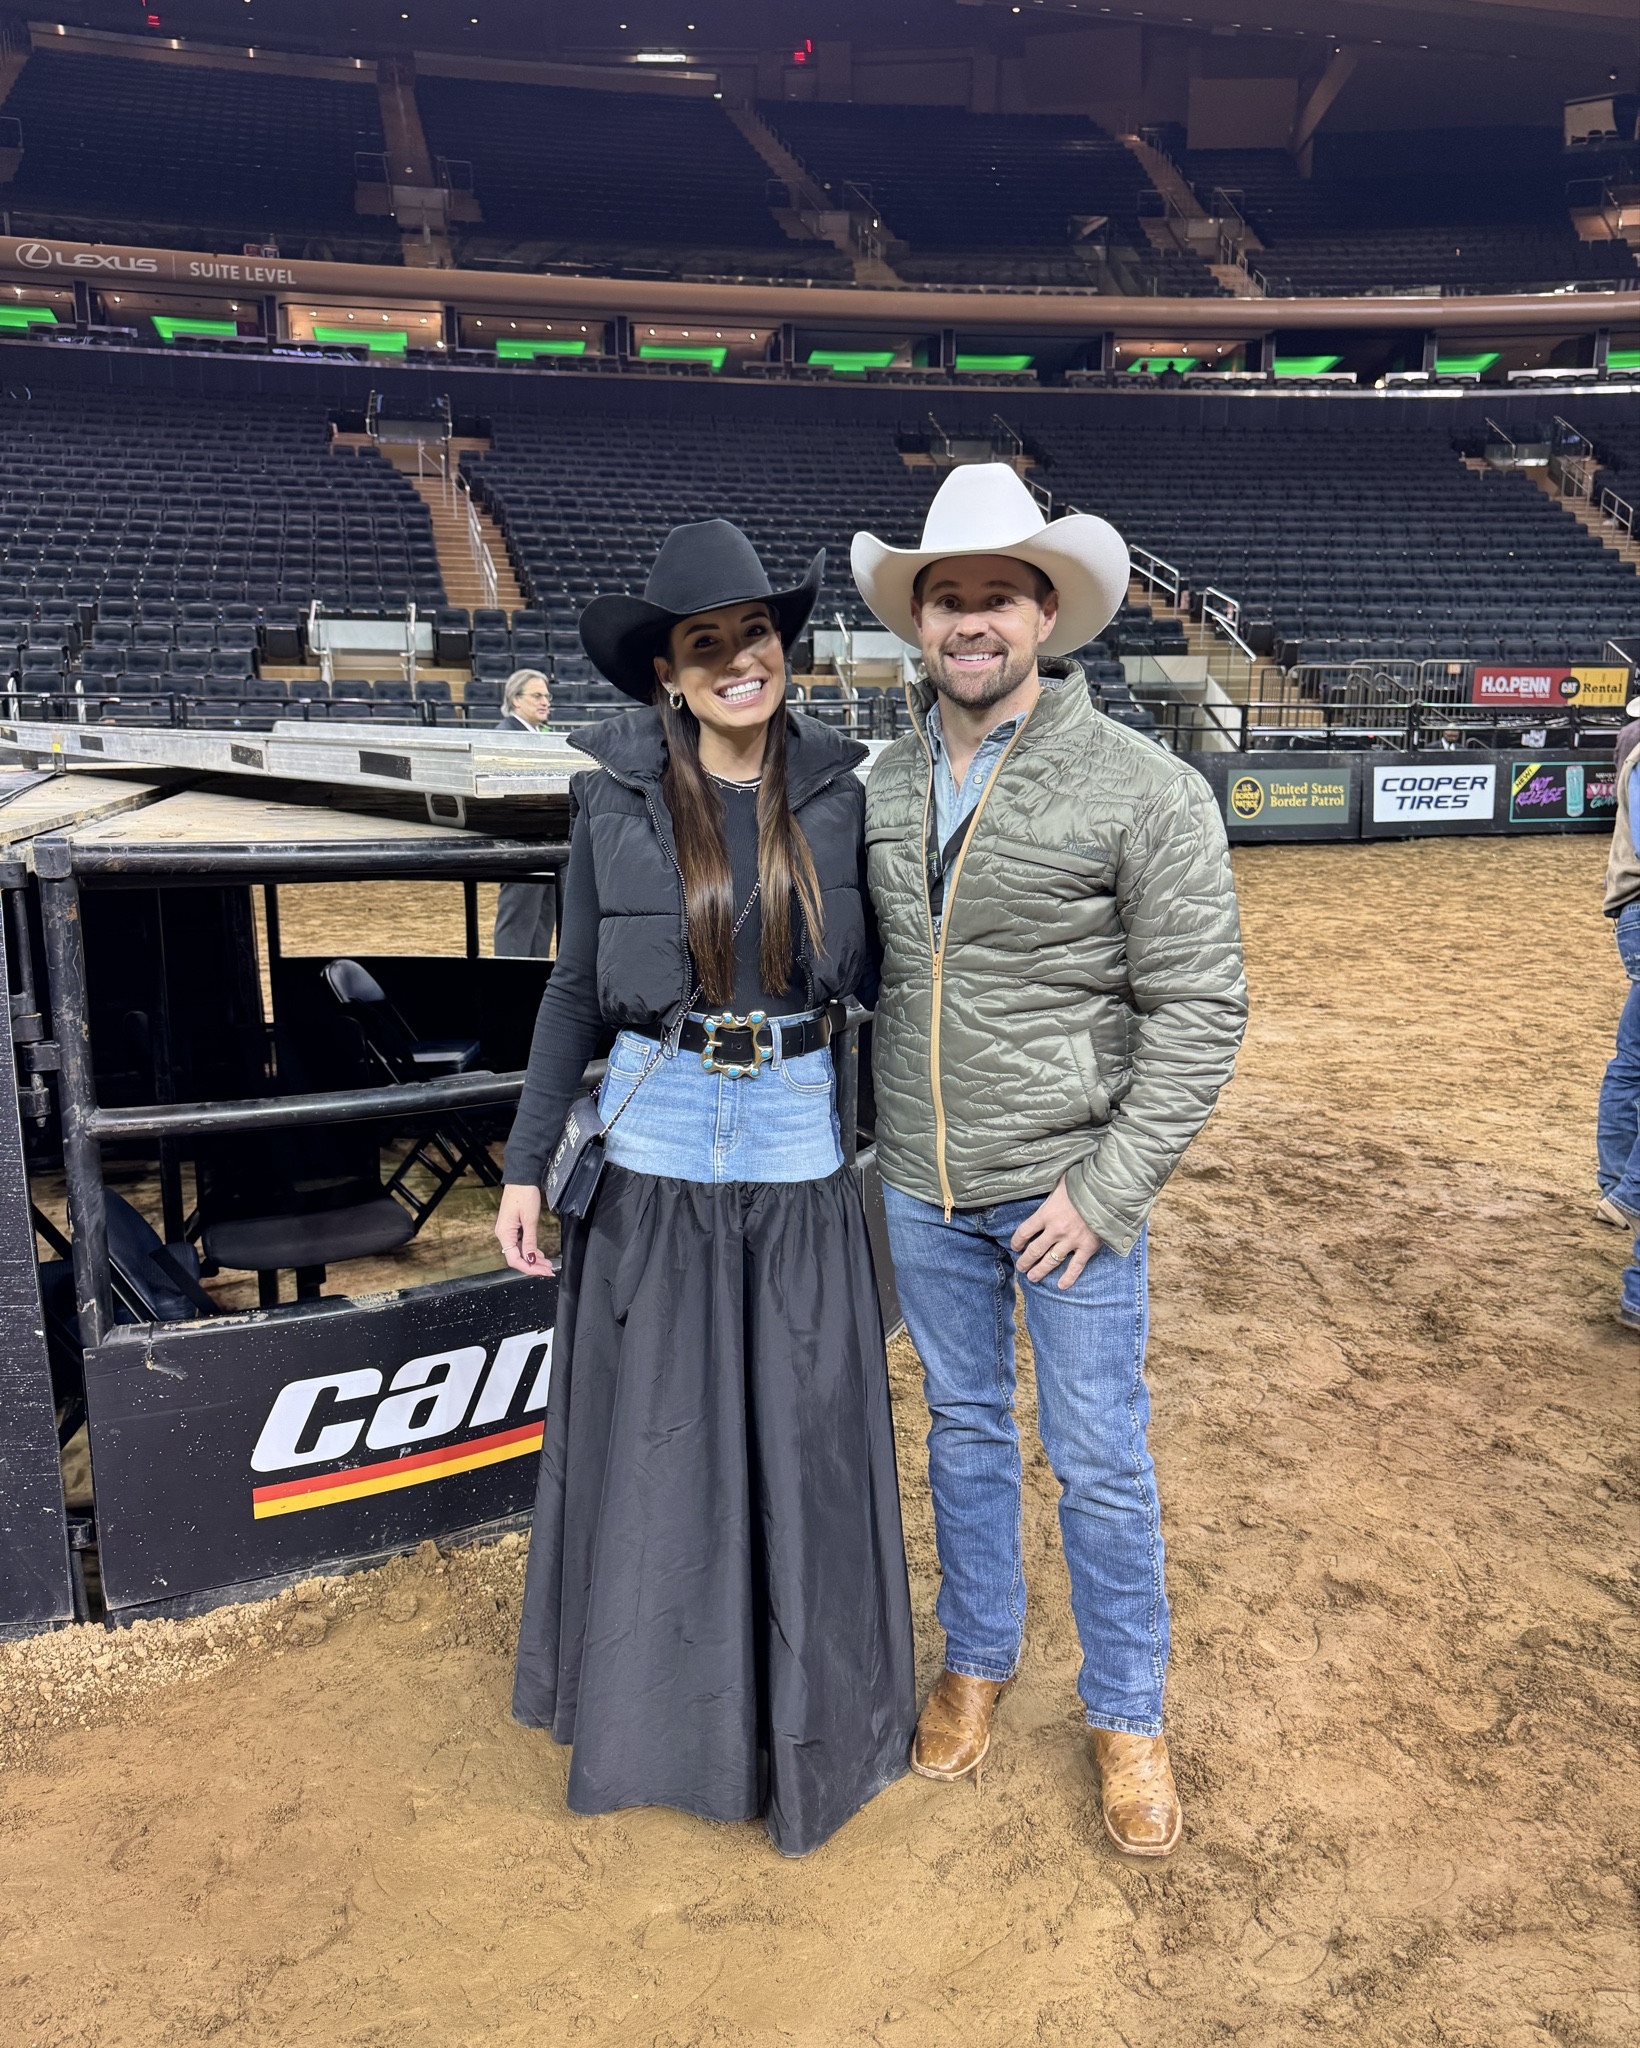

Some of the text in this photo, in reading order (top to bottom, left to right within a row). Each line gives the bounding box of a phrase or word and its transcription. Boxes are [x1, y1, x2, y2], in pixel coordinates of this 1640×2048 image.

[55, 251, 158, 273] LEXUS
[189, 261, 297, 285] SUITE LEVEL
[1480, 676, 1552, 693] H.O.PENN
[1561, 681, 1622, 694] CAT Rental
[1381, 776, 1488, 792] COOPER
[1515, 768, 1533, 789] NEW!
[1529, 776, 1554, 791] HOT
[1269, 782, 1344, 795] United States
[1515, 786, 1566, 807] RELEASE
[1269, 794, 1345, 808] Border Patrol
[1396, 794, 1470, 810] TIRES
